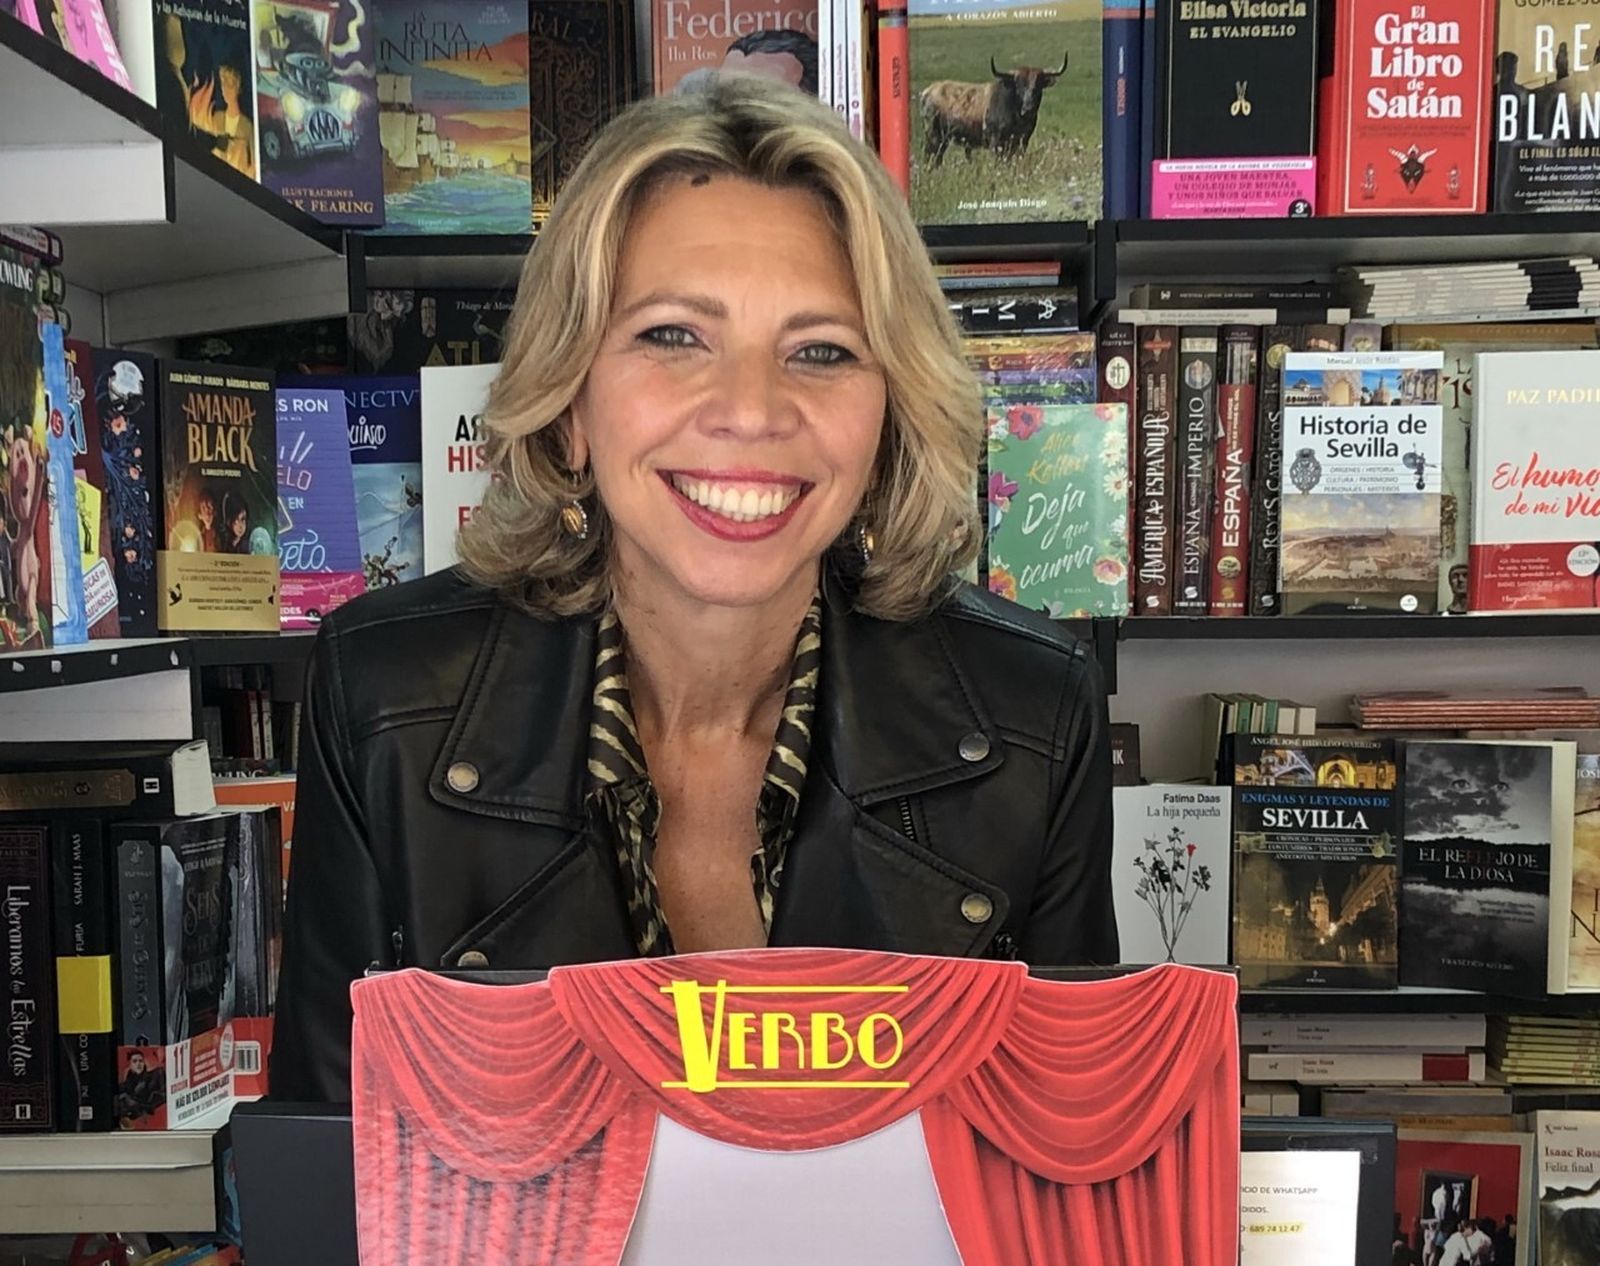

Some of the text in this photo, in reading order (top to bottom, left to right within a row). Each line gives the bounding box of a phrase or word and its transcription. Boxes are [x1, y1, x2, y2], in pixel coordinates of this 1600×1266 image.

[1012, 9, 1057, 18] ABIERTO
[1179, 0, 1307, 21] Elisa Victoria
[1411, 5, 1426, 19] El
[404, 21, 468, 41] RUTA
[1189, 24, 1297, 39] EL EVANGELIO
[1374, 13, 1460, 45] Gran
[380, 39, 493, 65] INFINITA
[692, 46, 717, 60] Ros
[1370, 47, 1463, 78] Libro
[1407, 78, 1424, 92] de
[1367, 87, 1462, 119] Satán
[1520, 148, 1528, 159] EL
[1530, 147, 1554, 158] FINAL
[1557, 147, 1567, 158] ES
[1174, 181, 1297, 191] UN COLEGIO DE MONJAS
[1180, 174, 1200, 182] UNA
[1203, 173, 1238, 181] JOVEN
[281, 187, 354, 198] ILUSTRACIONES
[1241, 191, 1262, 199] QUE
[311, 200, 374, 214] FEARING
[958, 200, 978, 210] José
[1020, 198, 1048, 209] Diego
[292, 398, 329, 413] RON
[1506, 389, 1541, 405] PAZ
[182, 391, 257, 427] AMANDA
[1300, 413, 1427, 436] Historia de
[1187, 396, 1206, 478] IMPERIO
[187, 422, 259, 473] BLACK
[1143, 410, 1170, 497] ESPAÑOLA
[1326, 437, 1399, 459] Sevilla
[1326, 476, 1354, 484] CULTURA
[1491, 462, 1519, 491] El
[288, 497, 304, 510] EN
[1221, 448, 1243, 547] ESPAÑA
[1504, 491, 1530, 516] de
[1533, 497, 1560, 515] mi
[1021, 482, 1086, 550] Deja
[1062, 520, 1090, 549] que
[1140, 499, 1167, 586] AMÉRICA
[1019, 544, 1094, 590] ocurra
[1250, 736, 1279, 746] ÁNGEL
[1281, 737, 1300, 746] JOSÉ
[1163, 793, 1221, 803] Fatima Daas
[1241, 793, 1390, 808] ENIGMAS Y LEYENDAS DE
[1147, 805, 1221, 819] La hija pequeña
[1262, 807, 1369, 830] SEVILLA
[72, 833, 81, 862] MAAS
[1419, 848, 1440, 861] EL
[1517, 853, 1539, 868] DE
[1445, 865, 1514, 883] LA DIOSA
[72, 870, 83, 906] SARAH
[1, 885, 32, 975] Liberamos
[75, 923, 85, 951] FURIA
[7, 998, 36, 1077] Estrellas
[671, 979, 904, 1093] VERBO
[79, 1050, 90, 1071] UNA
[1545, 1146, 1573, 1158] Isaac
[1545, 1161, 1594, 1173] Feliz final
[1260, 1186, 1271, 1194] DE
[1272, 1187, 1318, 1195] WHATSAPP
